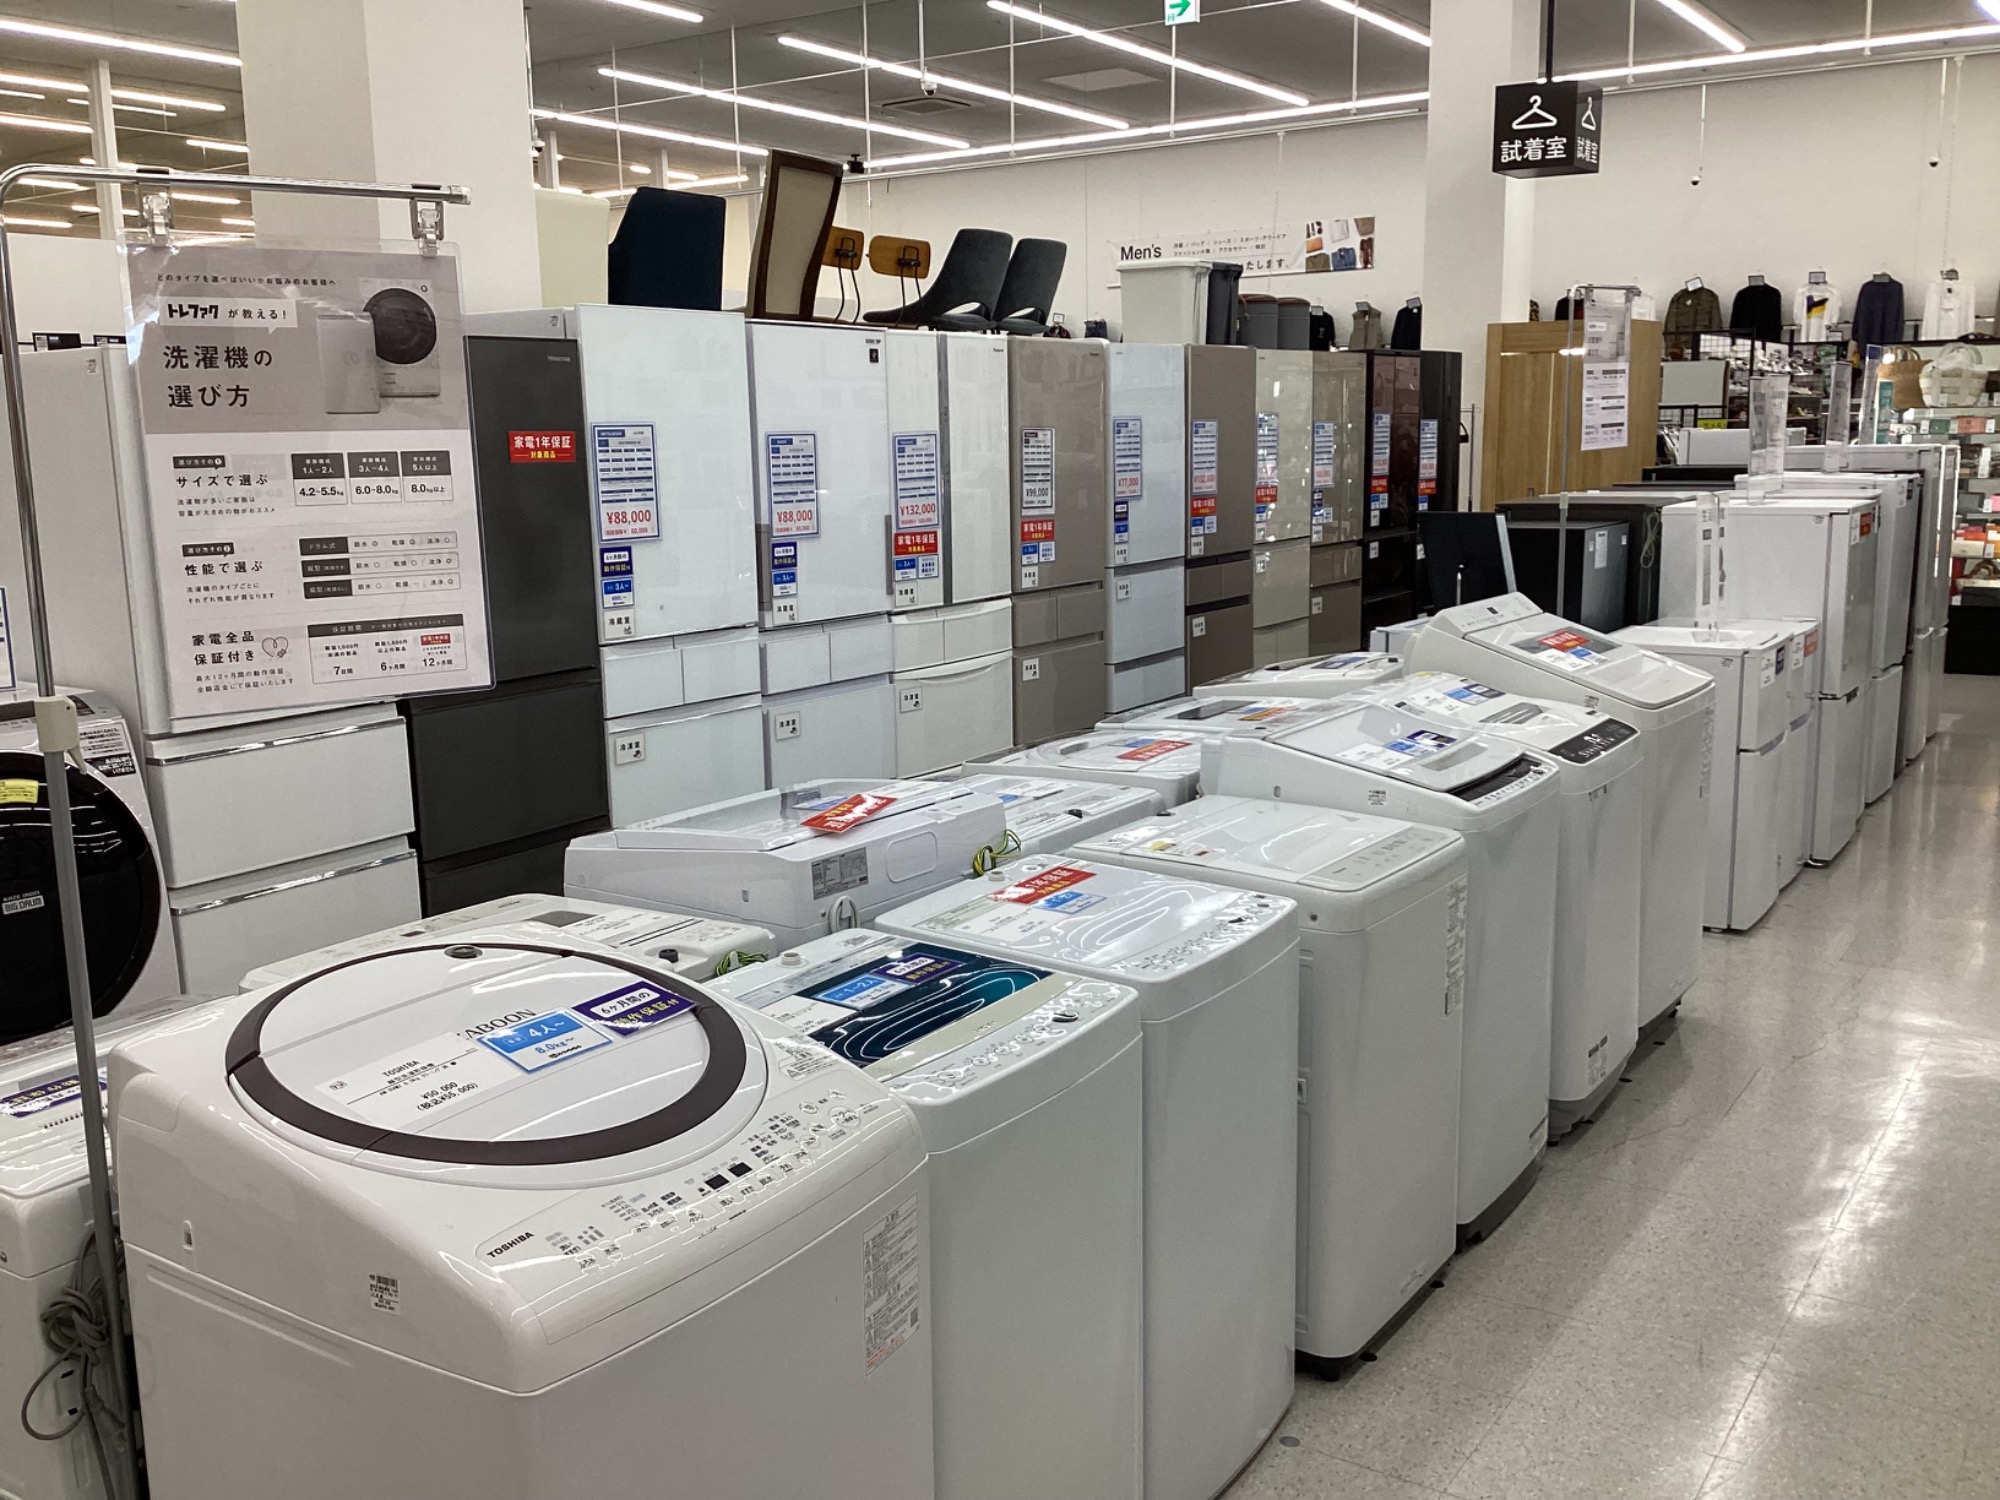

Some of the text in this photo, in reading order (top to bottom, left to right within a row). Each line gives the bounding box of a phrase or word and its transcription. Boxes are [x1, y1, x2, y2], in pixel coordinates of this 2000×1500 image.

[1501, 136, 1567, 163] 試着室
[1120, 244, 1162, 261] Men's
[163, 345, 272, 370] 洗濯機の
[168, 384, 250, 408] 選び方
[514, 435, 571, 449] 家電1年保証
[176, 474, 268, 488] サイズで選ぶ
[1026, 487, 1049, 498] ¥99,000
[776, 509, 814, 523] ¥88,000
[900, 503, 936, 516] ¥132,000
[606, 510, 652, 525] ¥88,000
[184, 561, 263, 576] 性能で選ぶ
[192, 631, 254, 646] 家電全品
[195, 650, 254, 666] 保証付き
[334, 666, 354, 675] 7日間
[602, 991, 651, 1014] 6ヶ月間の
[382, 1060, 420, 1078] TOSHIBA
[420, 1081, 458, 1100] ¥50,000
[487, 1232, 534, 1258] TOSHIBA
